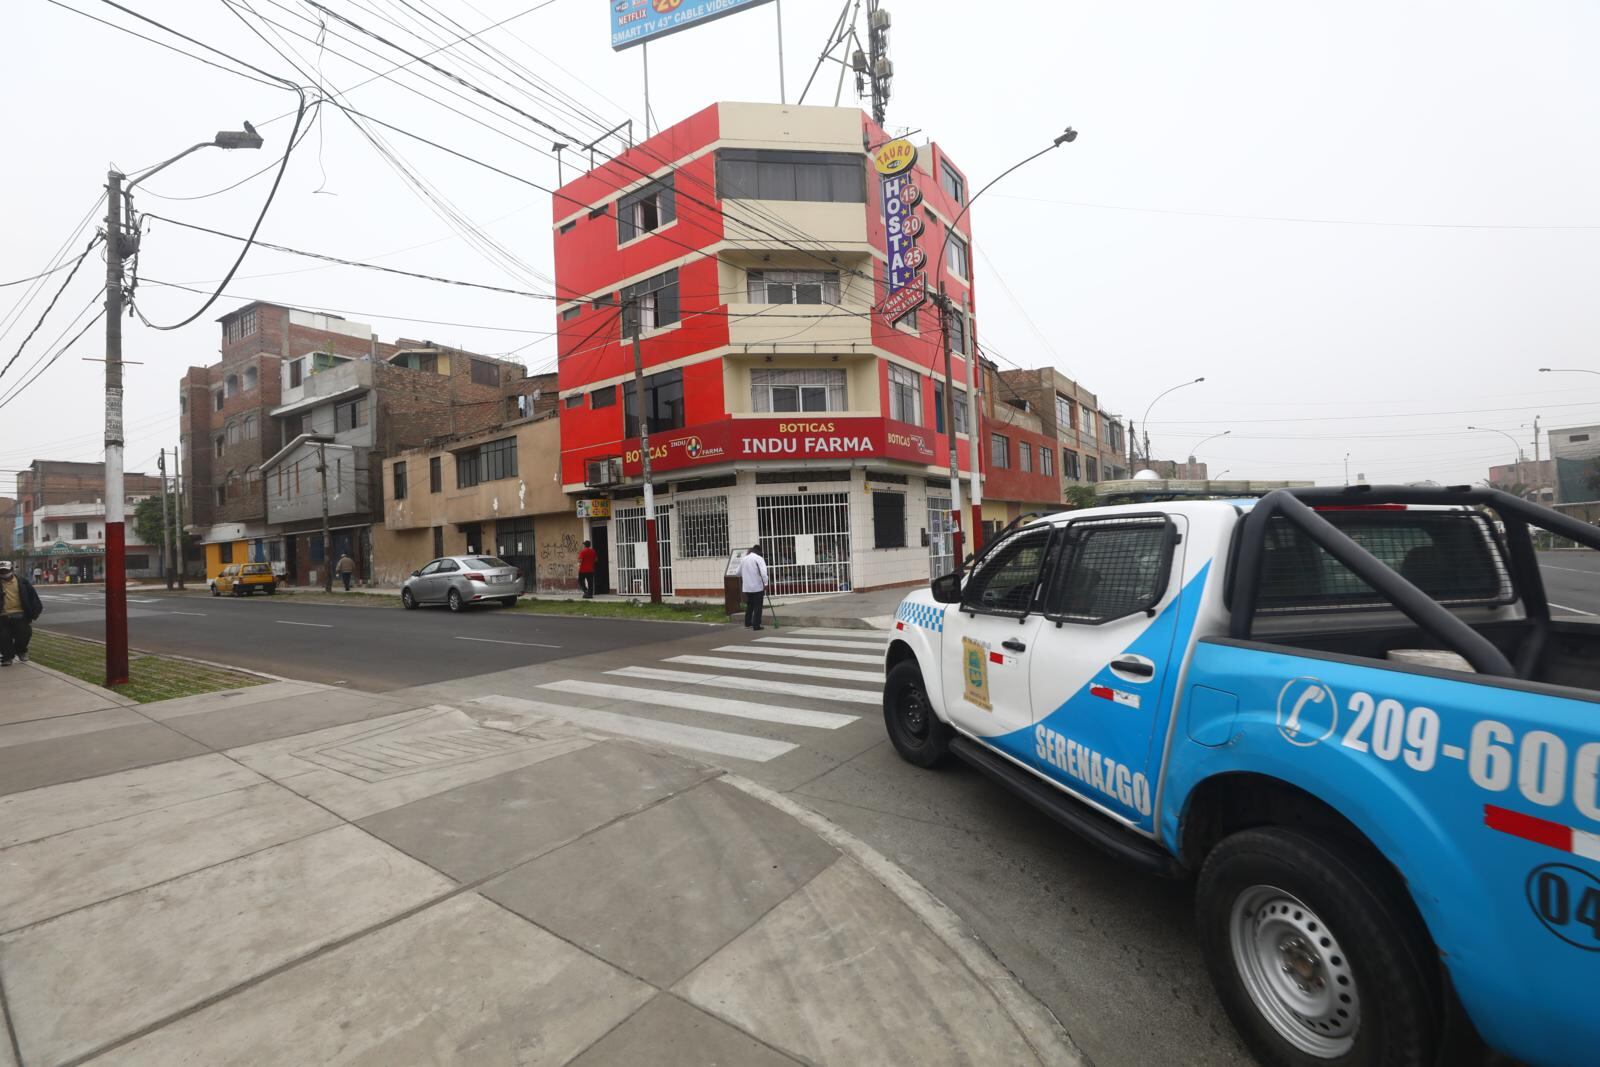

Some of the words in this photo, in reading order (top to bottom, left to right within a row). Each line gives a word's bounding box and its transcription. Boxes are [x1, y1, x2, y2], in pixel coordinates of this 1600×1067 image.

[612, 26, 641, 43] SMART
[644, 21, 656, 33] TV
[674, 5, 705, 23] CABLE
[618, 8, 648, 26] NETFLIX
[876, 145, 911, 165] TAURO
[903, 187, 916, 201] 15
[904, 219, 918, 234] 20
[886, 181, 905, 289] HOSTAL
[907, 250, 920, 265] 25
[780, 423, 835, 433] BOTICAS
[670, 440, 686, 448] INDU
[742, 438, 797, 453] INDU
[804, 437, 874, 453] FARMA
[887, 432, 911, 447] BOTICAS
[626, 445, 667, 463] BOTCAS
[702, 447, 723, 455] FARMA
[1035, 723, 1152, 816] SERENAZGO
